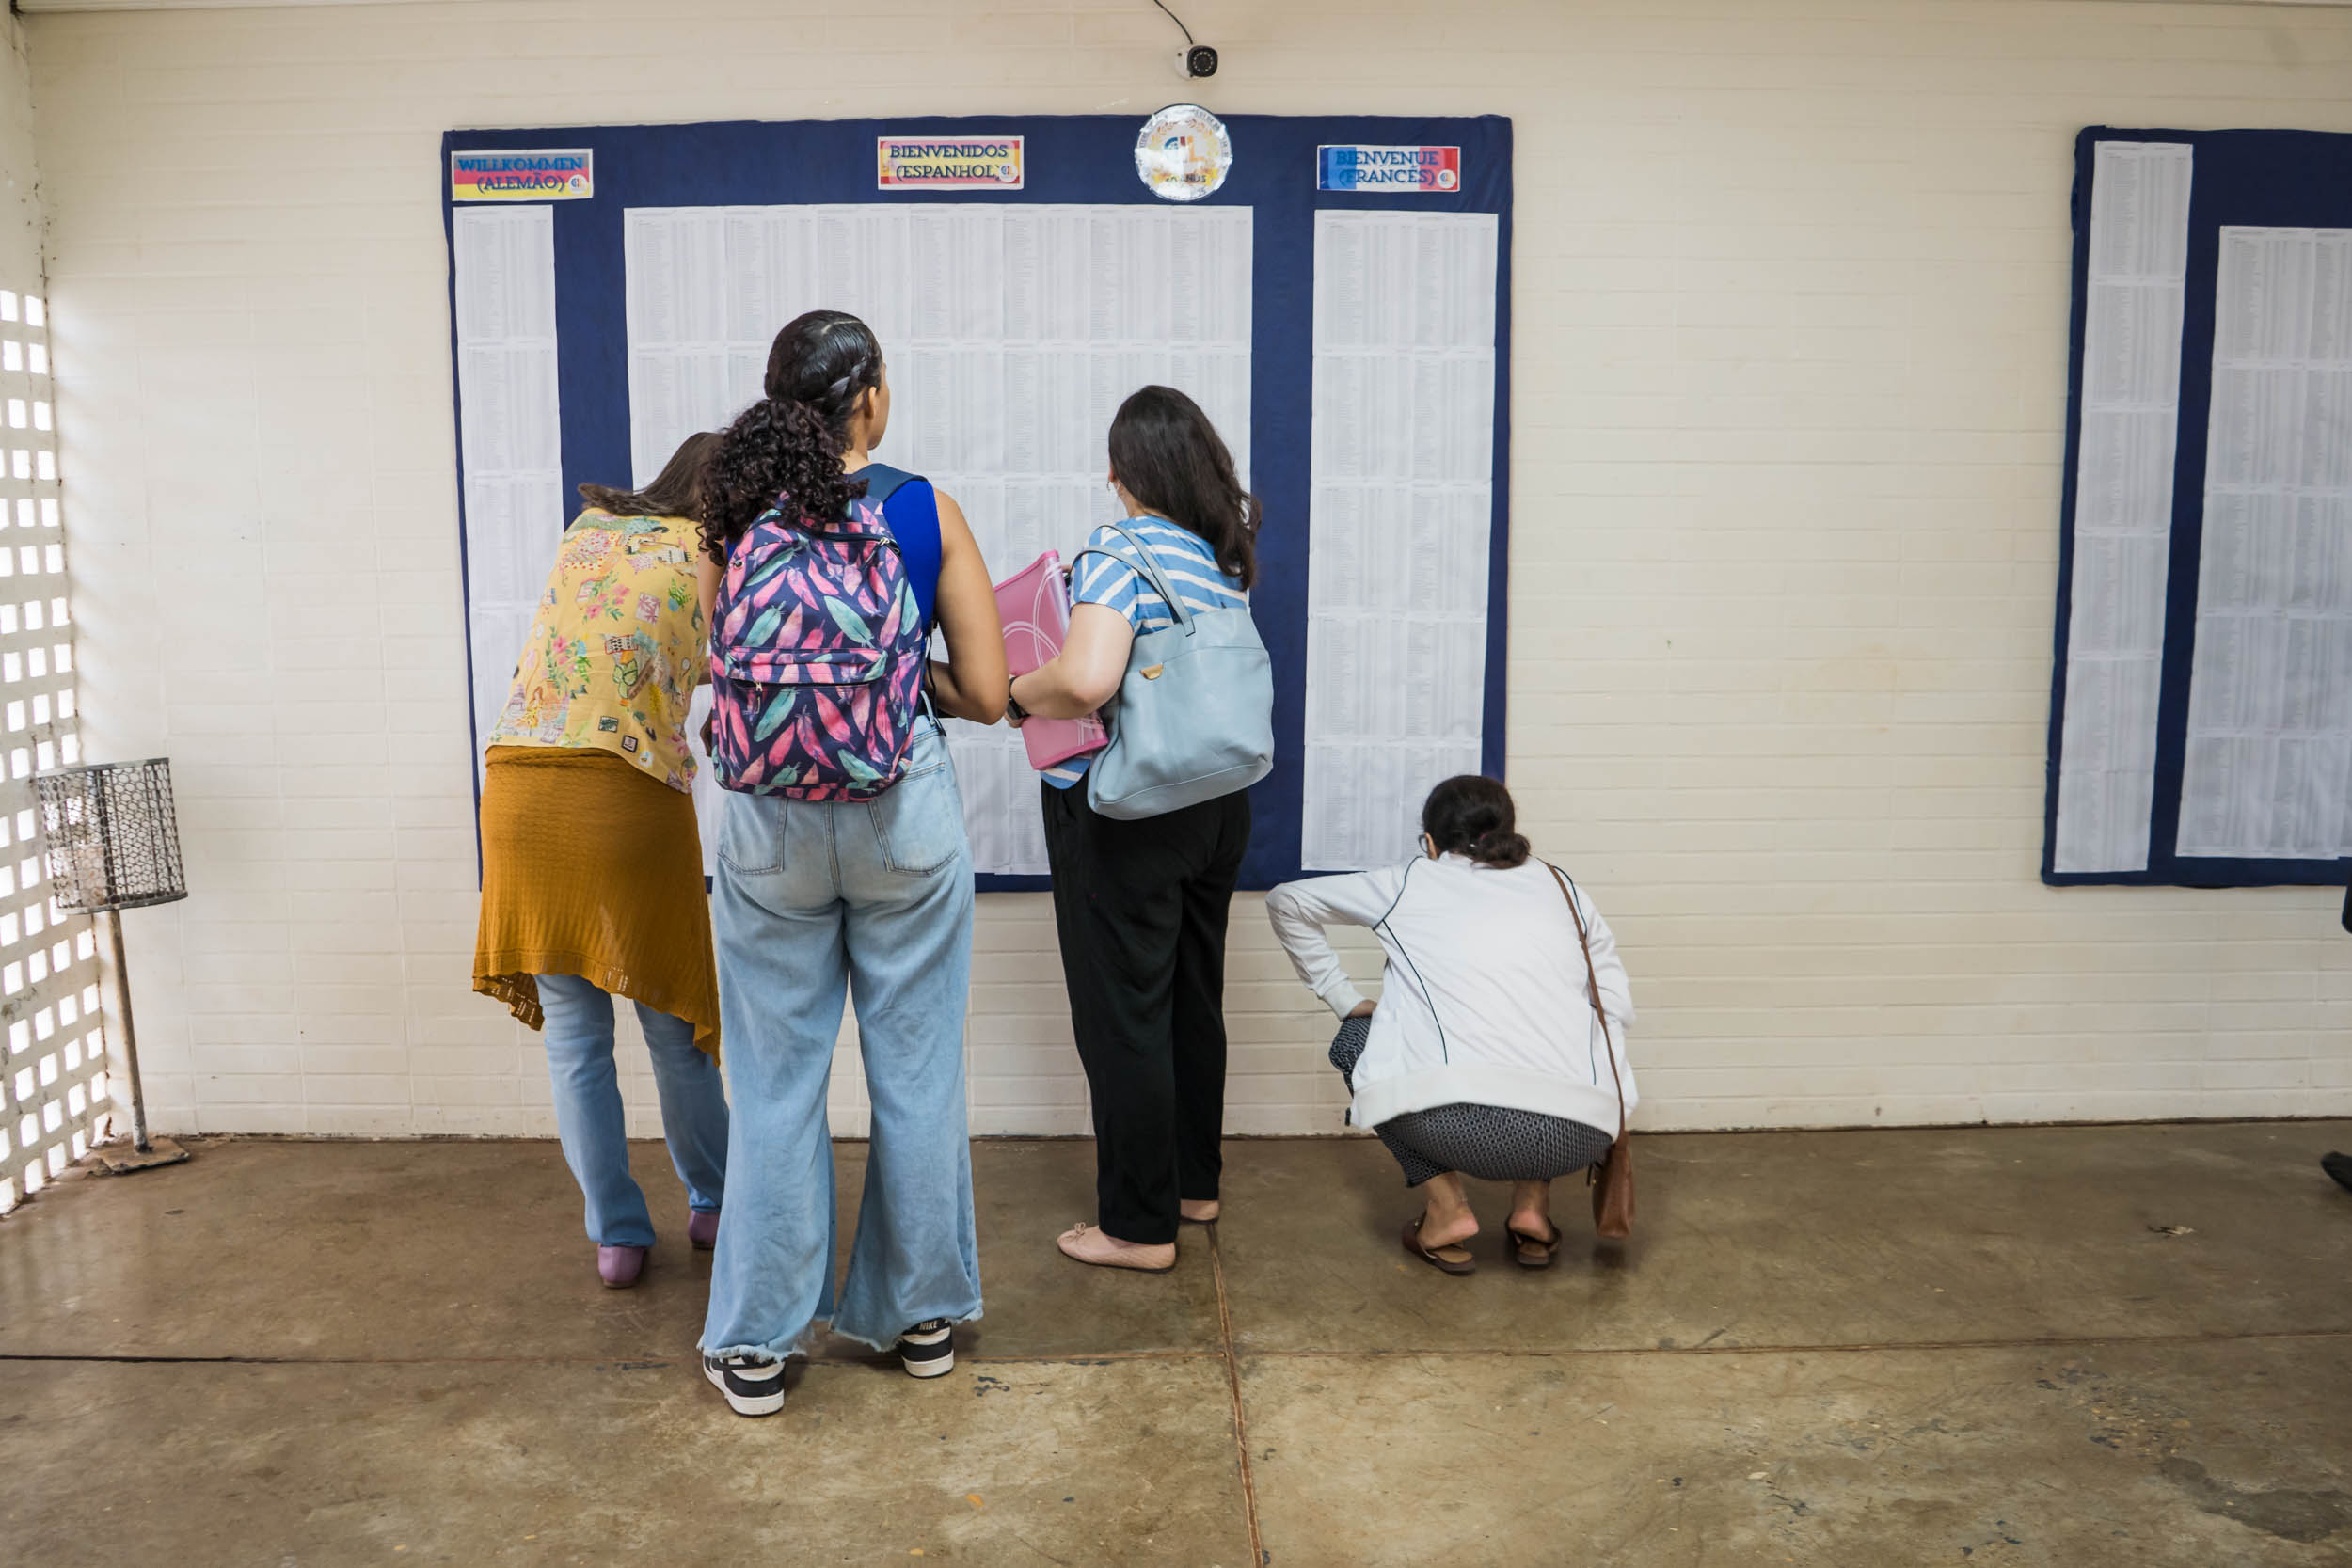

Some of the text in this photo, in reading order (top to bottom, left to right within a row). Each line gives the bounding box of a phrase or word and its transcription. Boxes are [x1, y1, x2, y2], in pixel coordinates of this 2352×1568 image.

[890, 144, 1009, 159] BIENVENIDOS
[1335, 150, 1439, 166] BIENVENUE
[457, 157, 583, 172] WILLKOMMEN
[476, 172, 565, 194] (ALEMÃO)
[1338, 165, 1436, 186] (FRANCÊS)
[919, 1320, 938, 1331] NIKE
